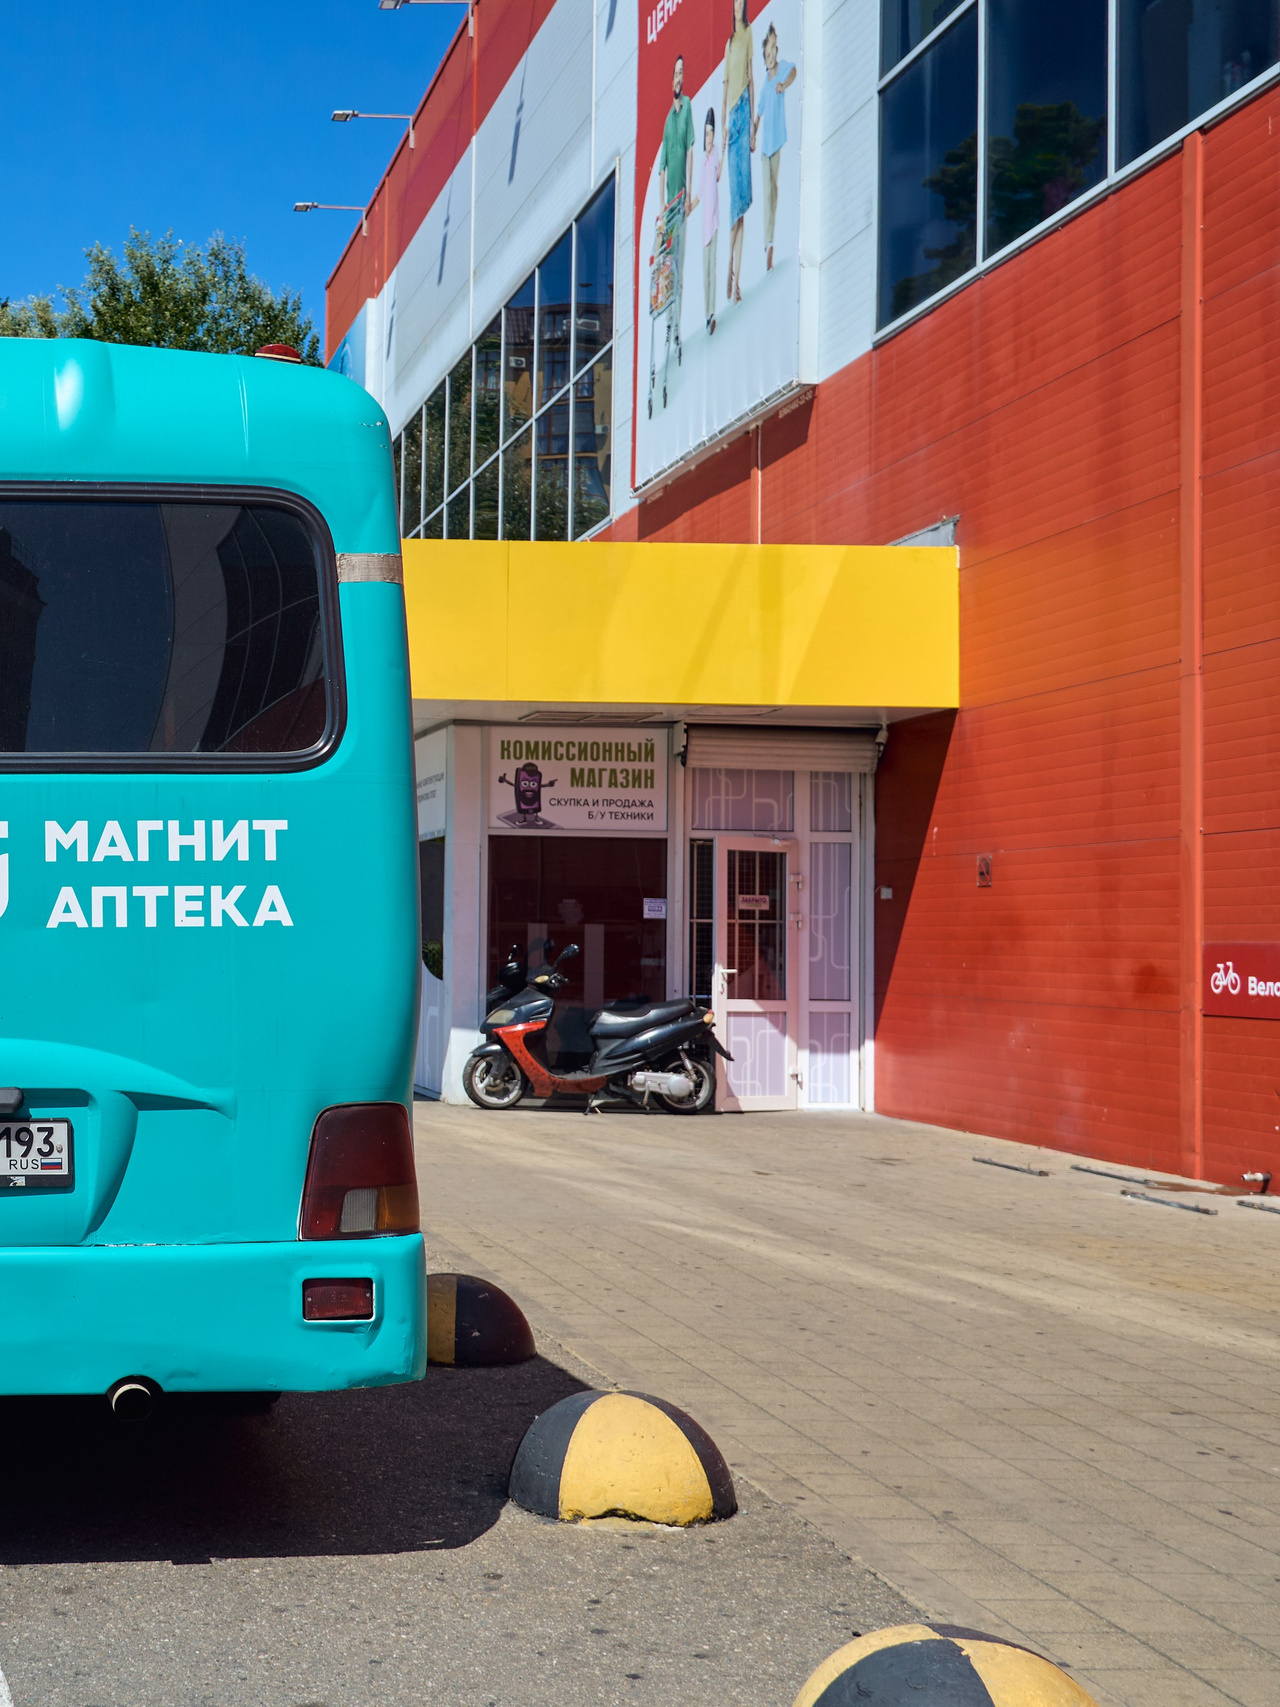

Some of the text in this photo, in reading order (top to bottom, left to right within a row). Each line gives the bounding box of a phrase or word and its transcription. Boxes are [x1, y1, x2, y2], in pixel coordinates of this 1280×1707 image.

[500, 738, 655, 763] КОМИССИОННЫЙ
[570, 767, 655, 789] МАГАЗИН
[549, 797, 654, 809] СКУПКА И ПРОДАЖА
[587, 811, 654, 821] Б/У ТЕХНИКИ
[44, 819, 288, 863] МАГНИТ
[45, 885, 294, 929] АПТЕКА
[8, 1158, 40, 1170] RUS
